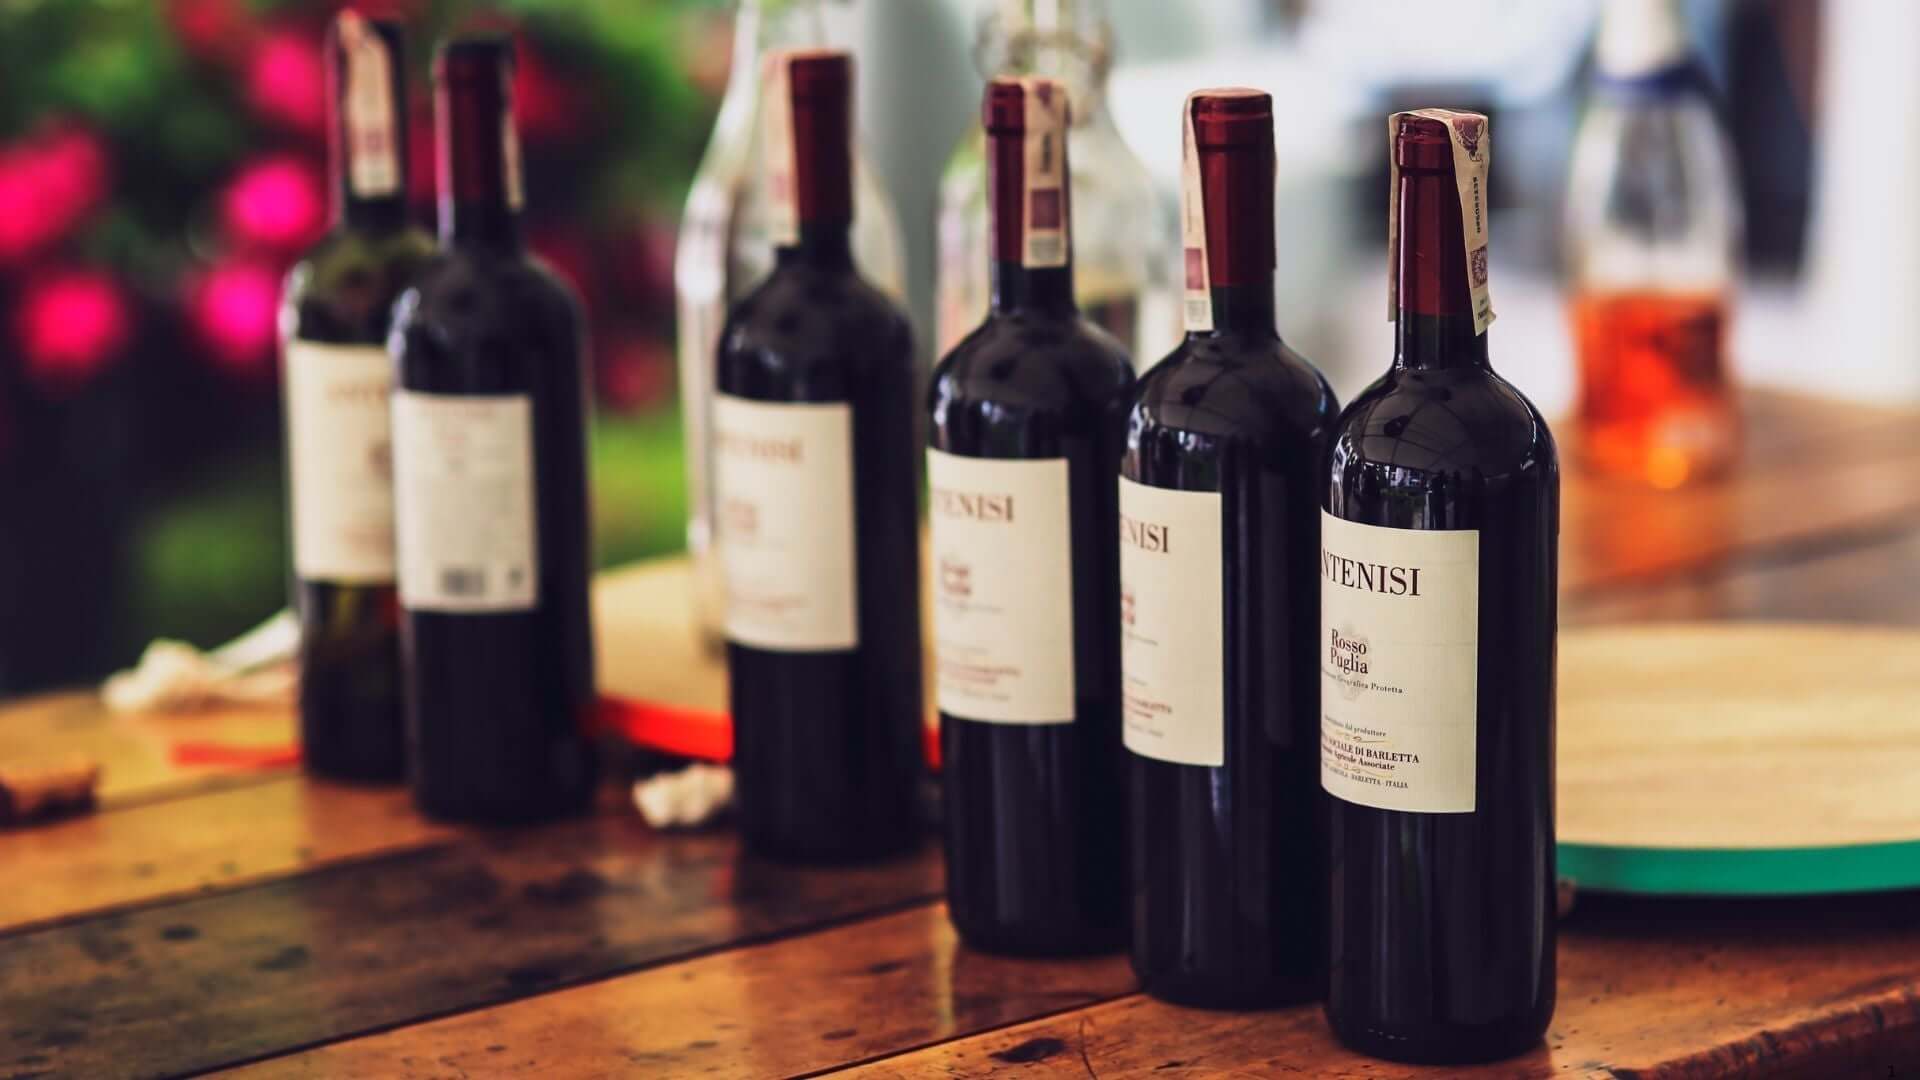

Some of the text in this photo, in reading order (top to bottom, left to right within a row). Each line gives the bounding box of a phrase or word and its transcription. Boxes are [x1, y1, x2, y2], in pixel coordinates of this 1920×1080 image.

[1322, 548, 1421, 596] NTENISI
[1331, 628, 1367, 655] Rosso
[1330, 646, 1369, 675] Puglia
[1370, 682, 1403, 694] Protetta
[1354, 746, 1364, 756] DI
[1365, 748, 1420, 764] BARLETTA
[1358, 757, 1395, 771] Associate
[1385, 780, 1409, 789] ITALIA
